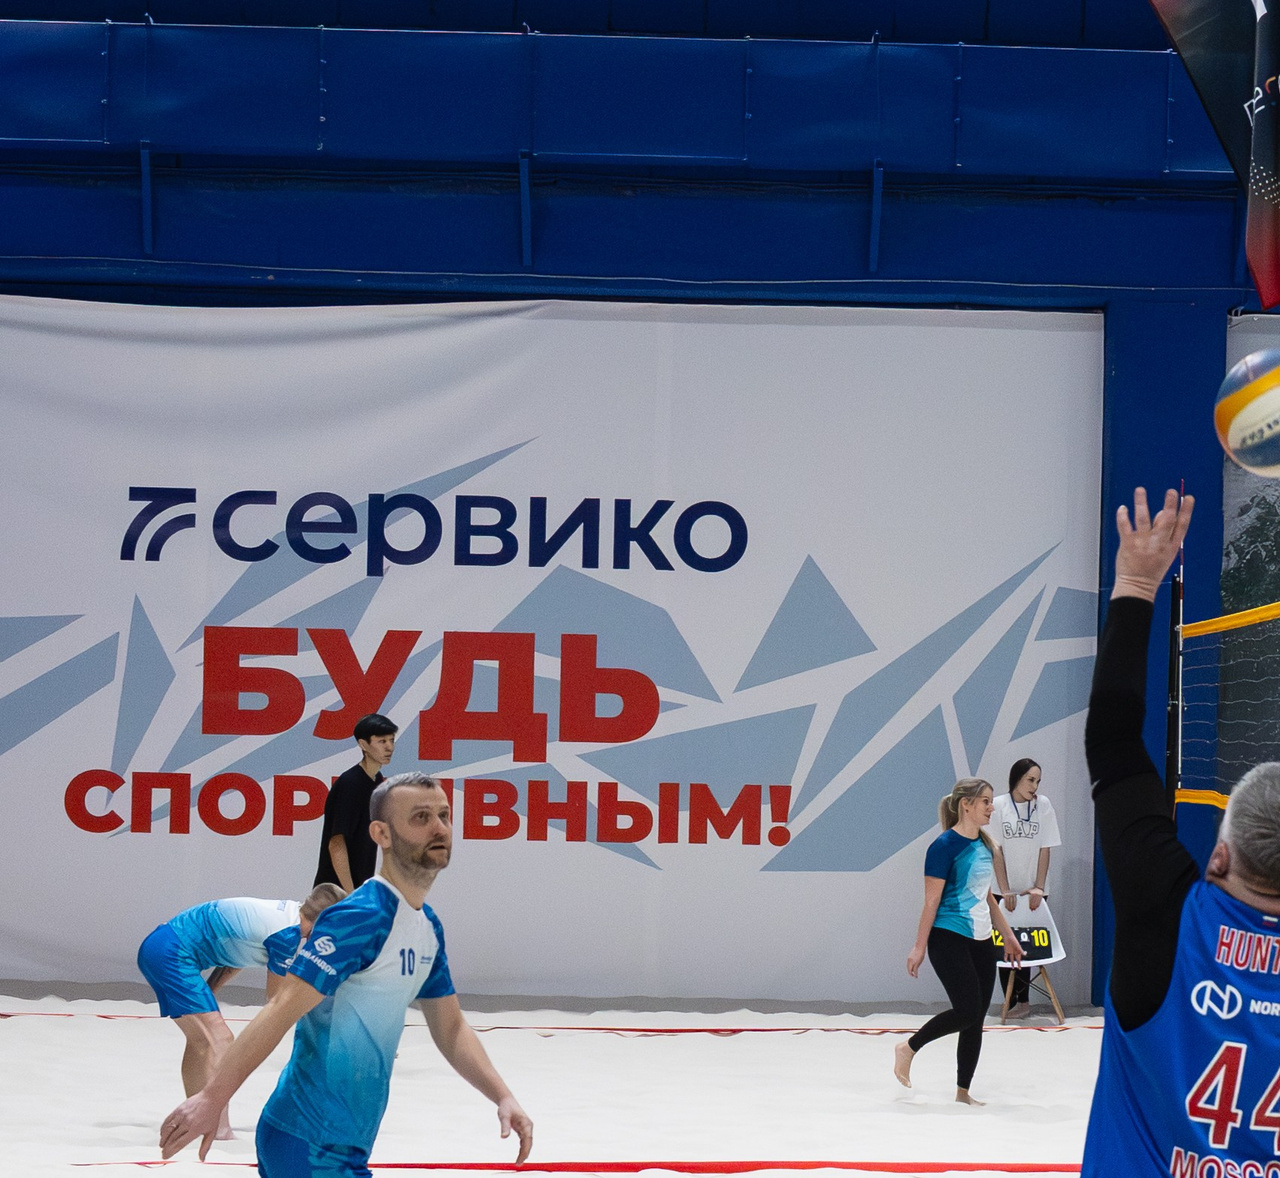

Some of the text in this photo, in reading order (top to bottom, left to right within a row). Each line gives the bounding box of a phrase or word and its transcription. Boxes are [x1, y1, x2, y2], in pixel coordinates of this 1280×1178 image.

[211, 488, 748, 577] сервико
[201, 625, 661, 763] БУДЬ
[63, 768, 794, 847] СПОРВНЫМ!
[1002, 821, 1040, 840] GAP
[399, 947, 416, 976] 10
[1031, 929, 1049, 947] 10
